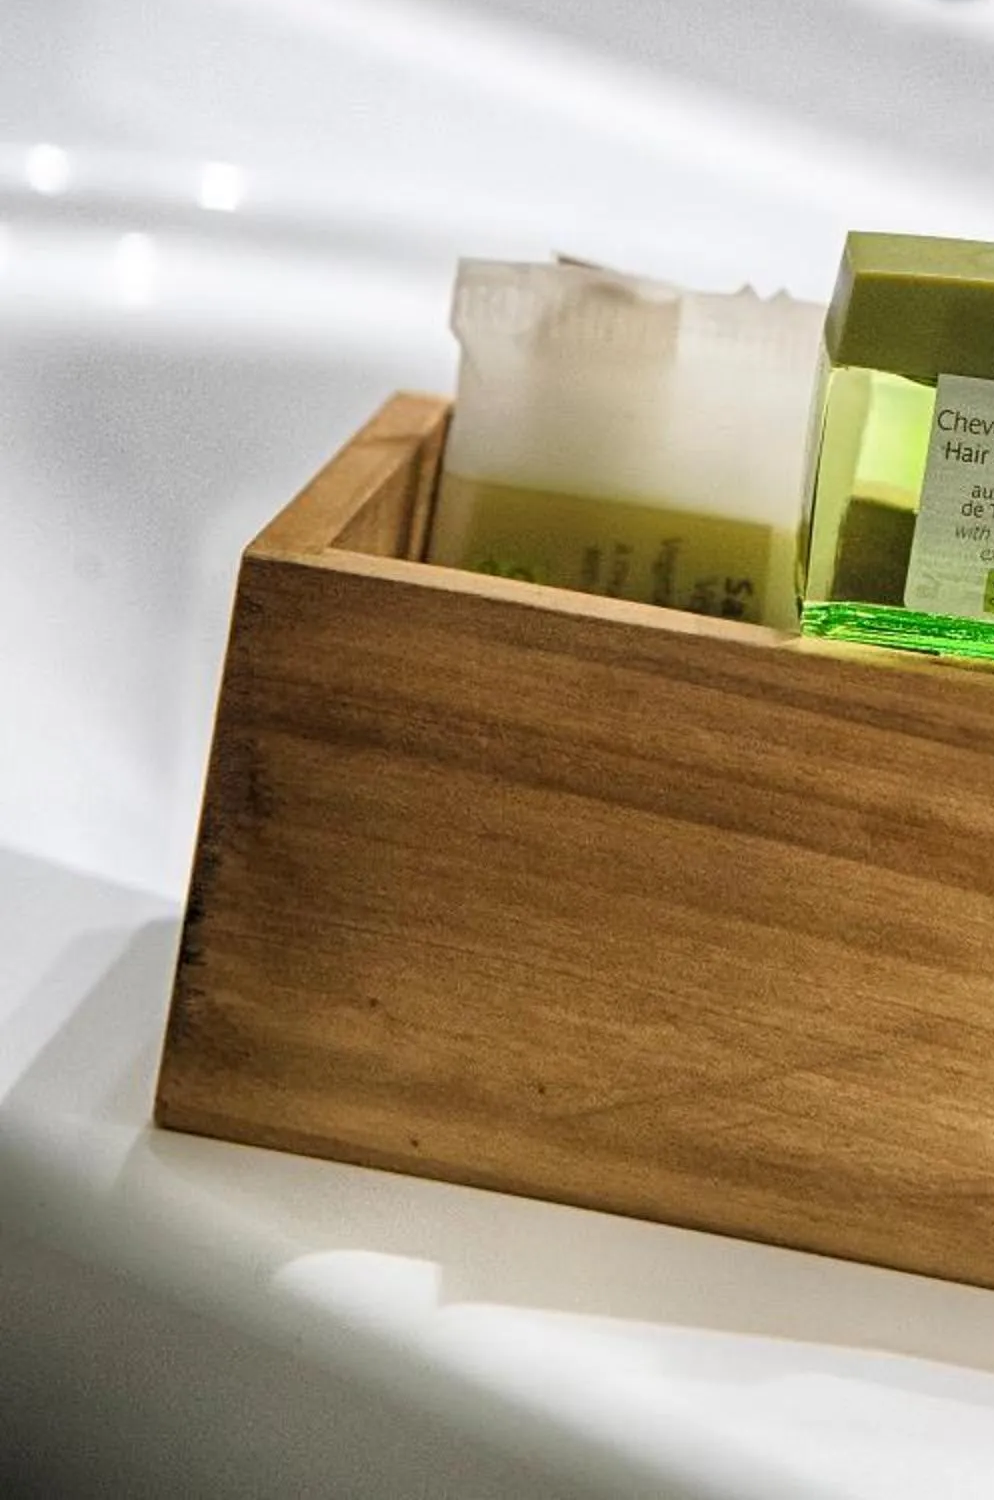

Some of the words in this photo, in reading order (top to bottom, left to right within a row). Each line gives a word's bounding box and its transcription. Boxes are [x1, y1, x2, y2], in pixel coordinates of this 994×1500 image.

[944, 441, 989, 465] Hair
[961, 500, 984, 518] de
[955, 525, 991, 541] with
